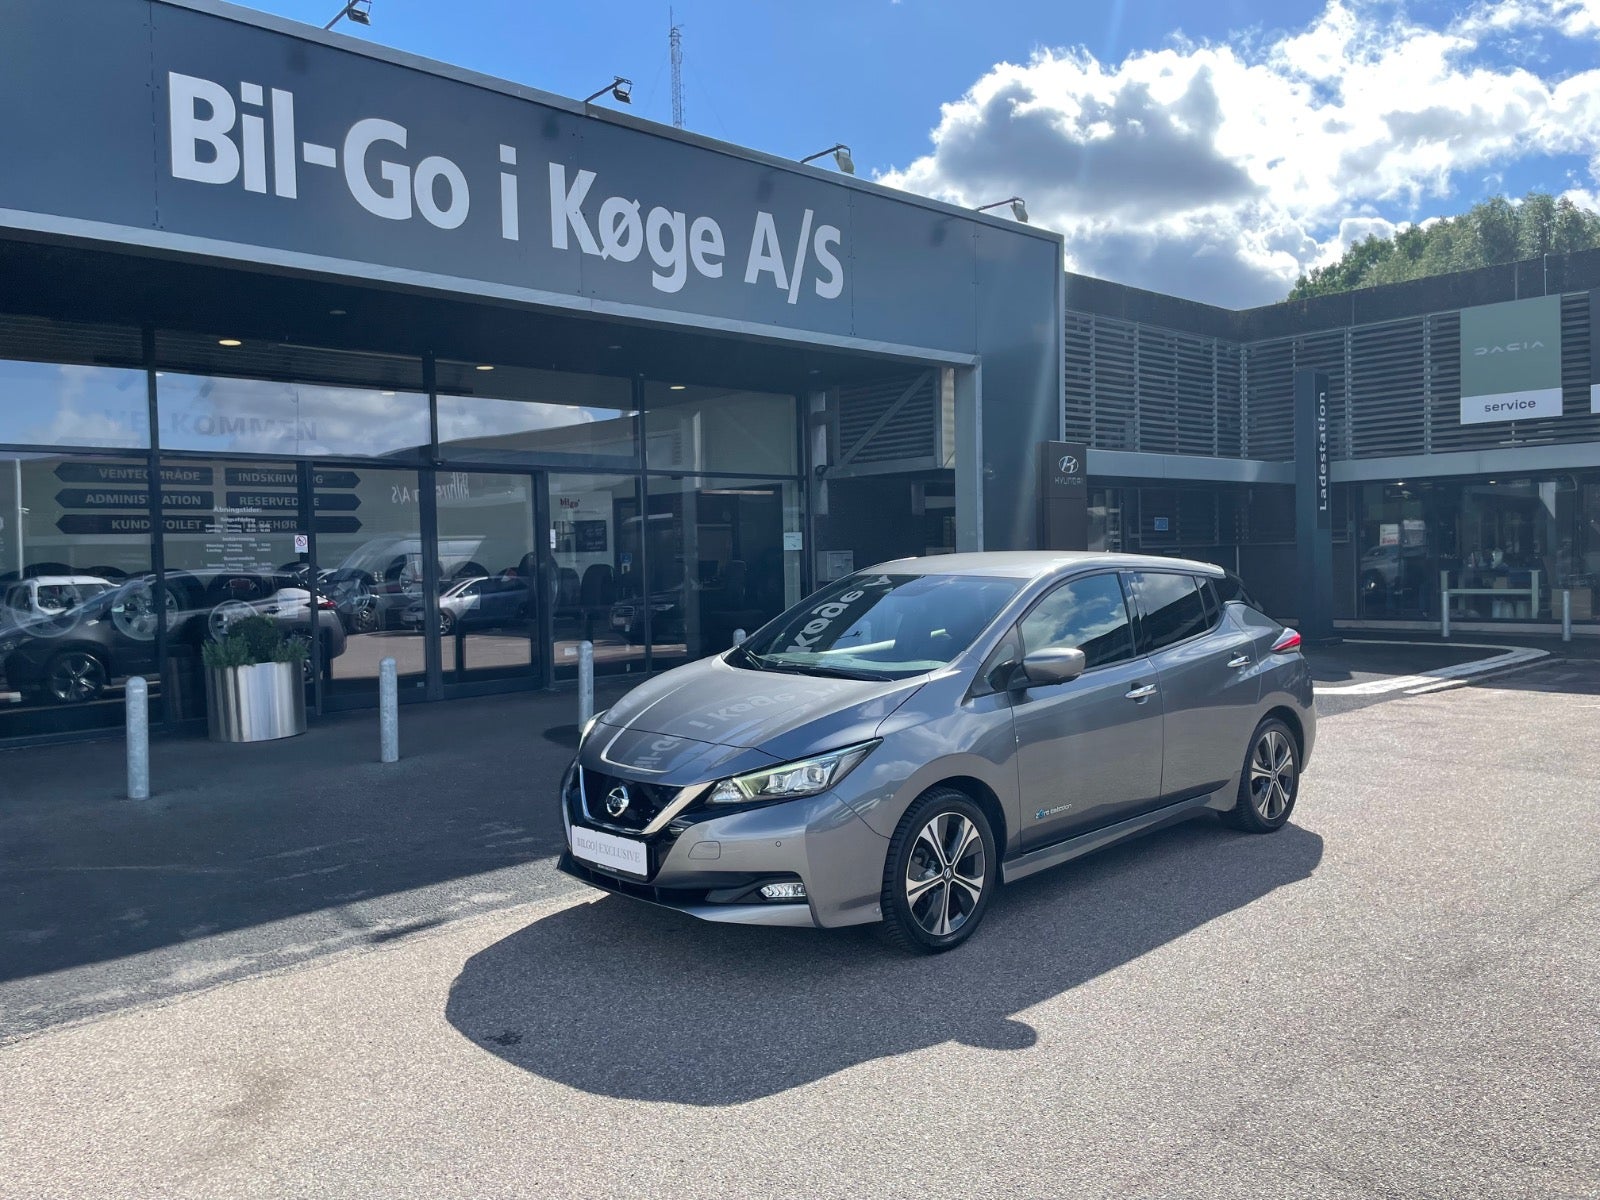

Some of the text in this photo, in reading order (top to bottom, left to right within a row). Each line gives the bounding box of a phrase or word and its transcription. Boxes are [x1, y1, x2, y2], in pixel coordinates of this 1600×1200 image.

[168, 71, 845, 305] Bil-Go i Køge A/S
[1473, 341, 1545, 356] DACIA
[1484, 399, 1537, 413] service
[104, 408, 318, 442] VEKOMMEN
[1318, 391, 1328, 512] Ladestation
[99, 468, 201, 481] VENTERÅDE
[238, 472, 323, 484] INDSKRIVG
[86, 493, 202, 505] ADMINISATION
[239, 496, 320, 507] RESERVEDE
[111, 519, 202, 530] KUNDOILET
